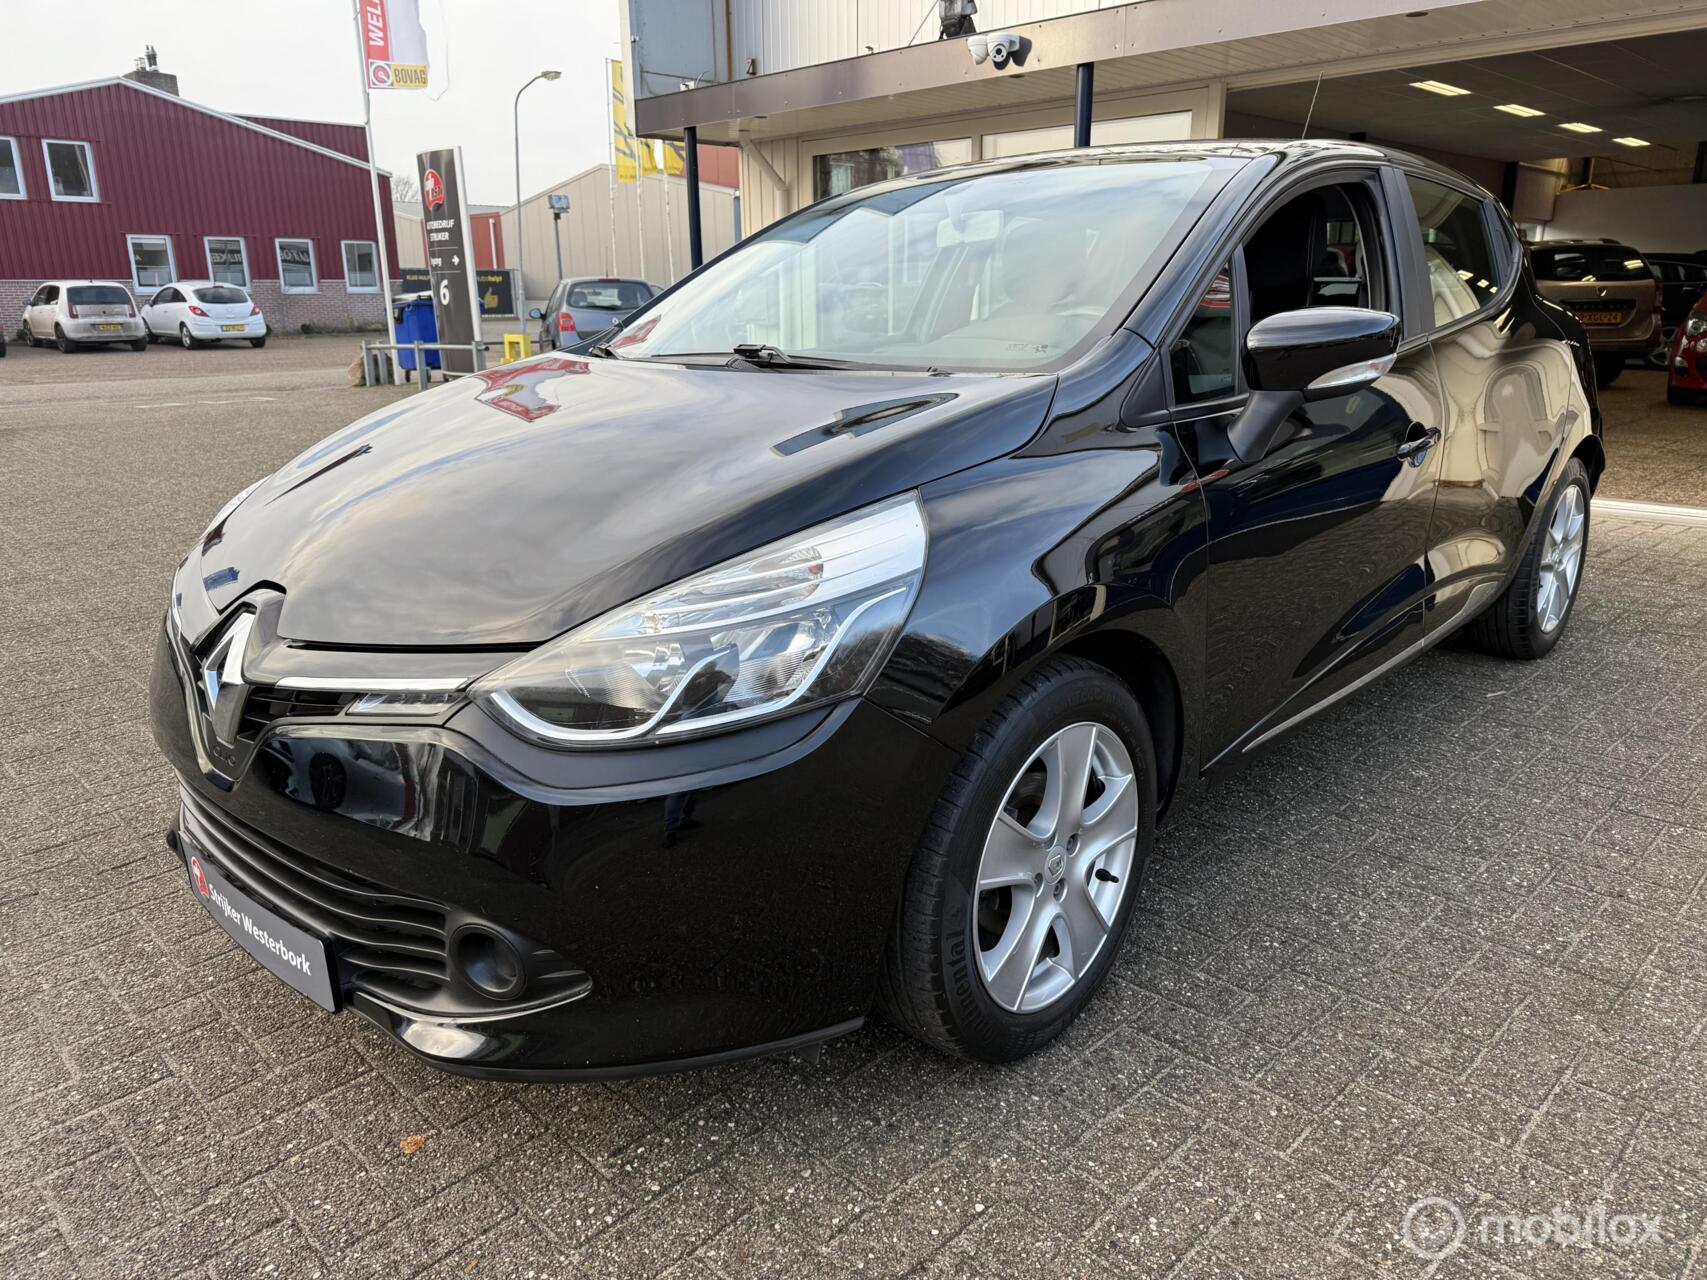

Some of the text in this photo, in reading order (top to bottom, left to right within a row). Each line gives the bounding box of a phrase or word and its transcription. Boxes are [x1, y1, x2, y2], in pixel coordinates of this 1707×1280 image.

[394, 68, 427, 84] BOVAG
[439, 279, 449, 306] 6
[209, 883, 311, 976] Strijker Westerbork
